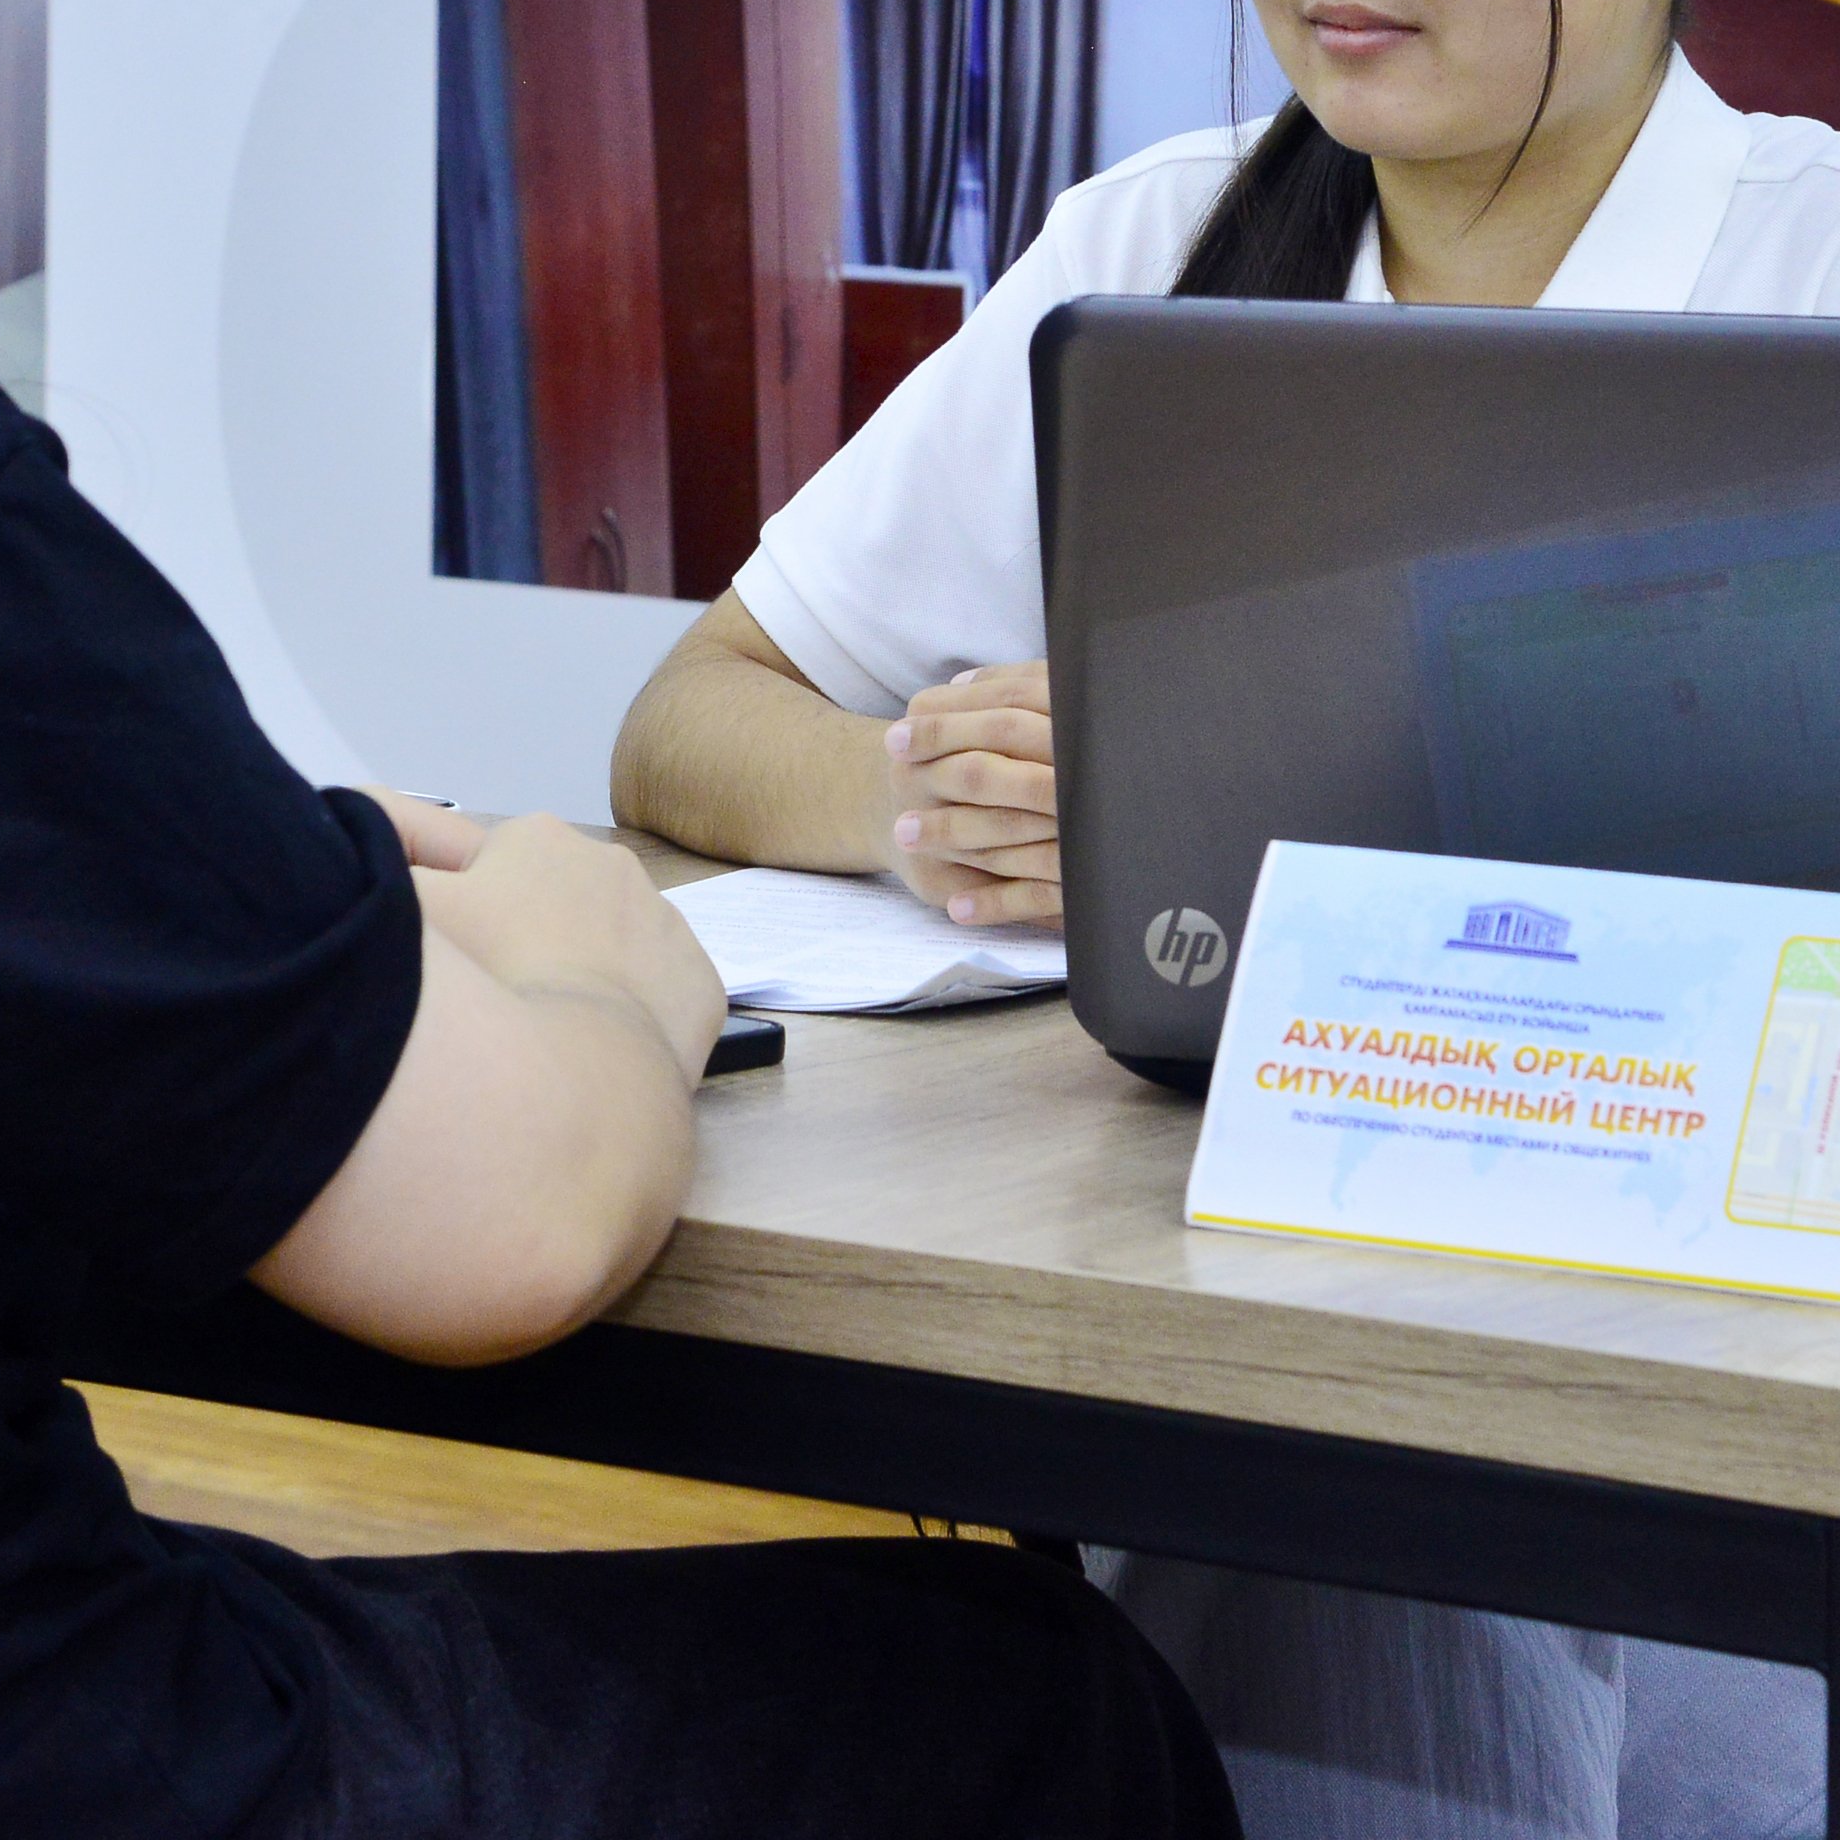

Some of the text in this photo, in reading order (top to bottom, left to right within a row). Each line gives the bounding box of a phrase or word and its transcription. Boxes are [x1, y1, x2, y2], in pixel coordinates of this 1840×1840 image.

[1158, 906, 1219, 988] hp
[1282, 1018, 1698, 1096] АХУАЛДЫҚ ОРТАЛЫҚ
[1255, 1062, 1708, 1140] СИТУАЦИОННЫЙ ЦЕНТР
